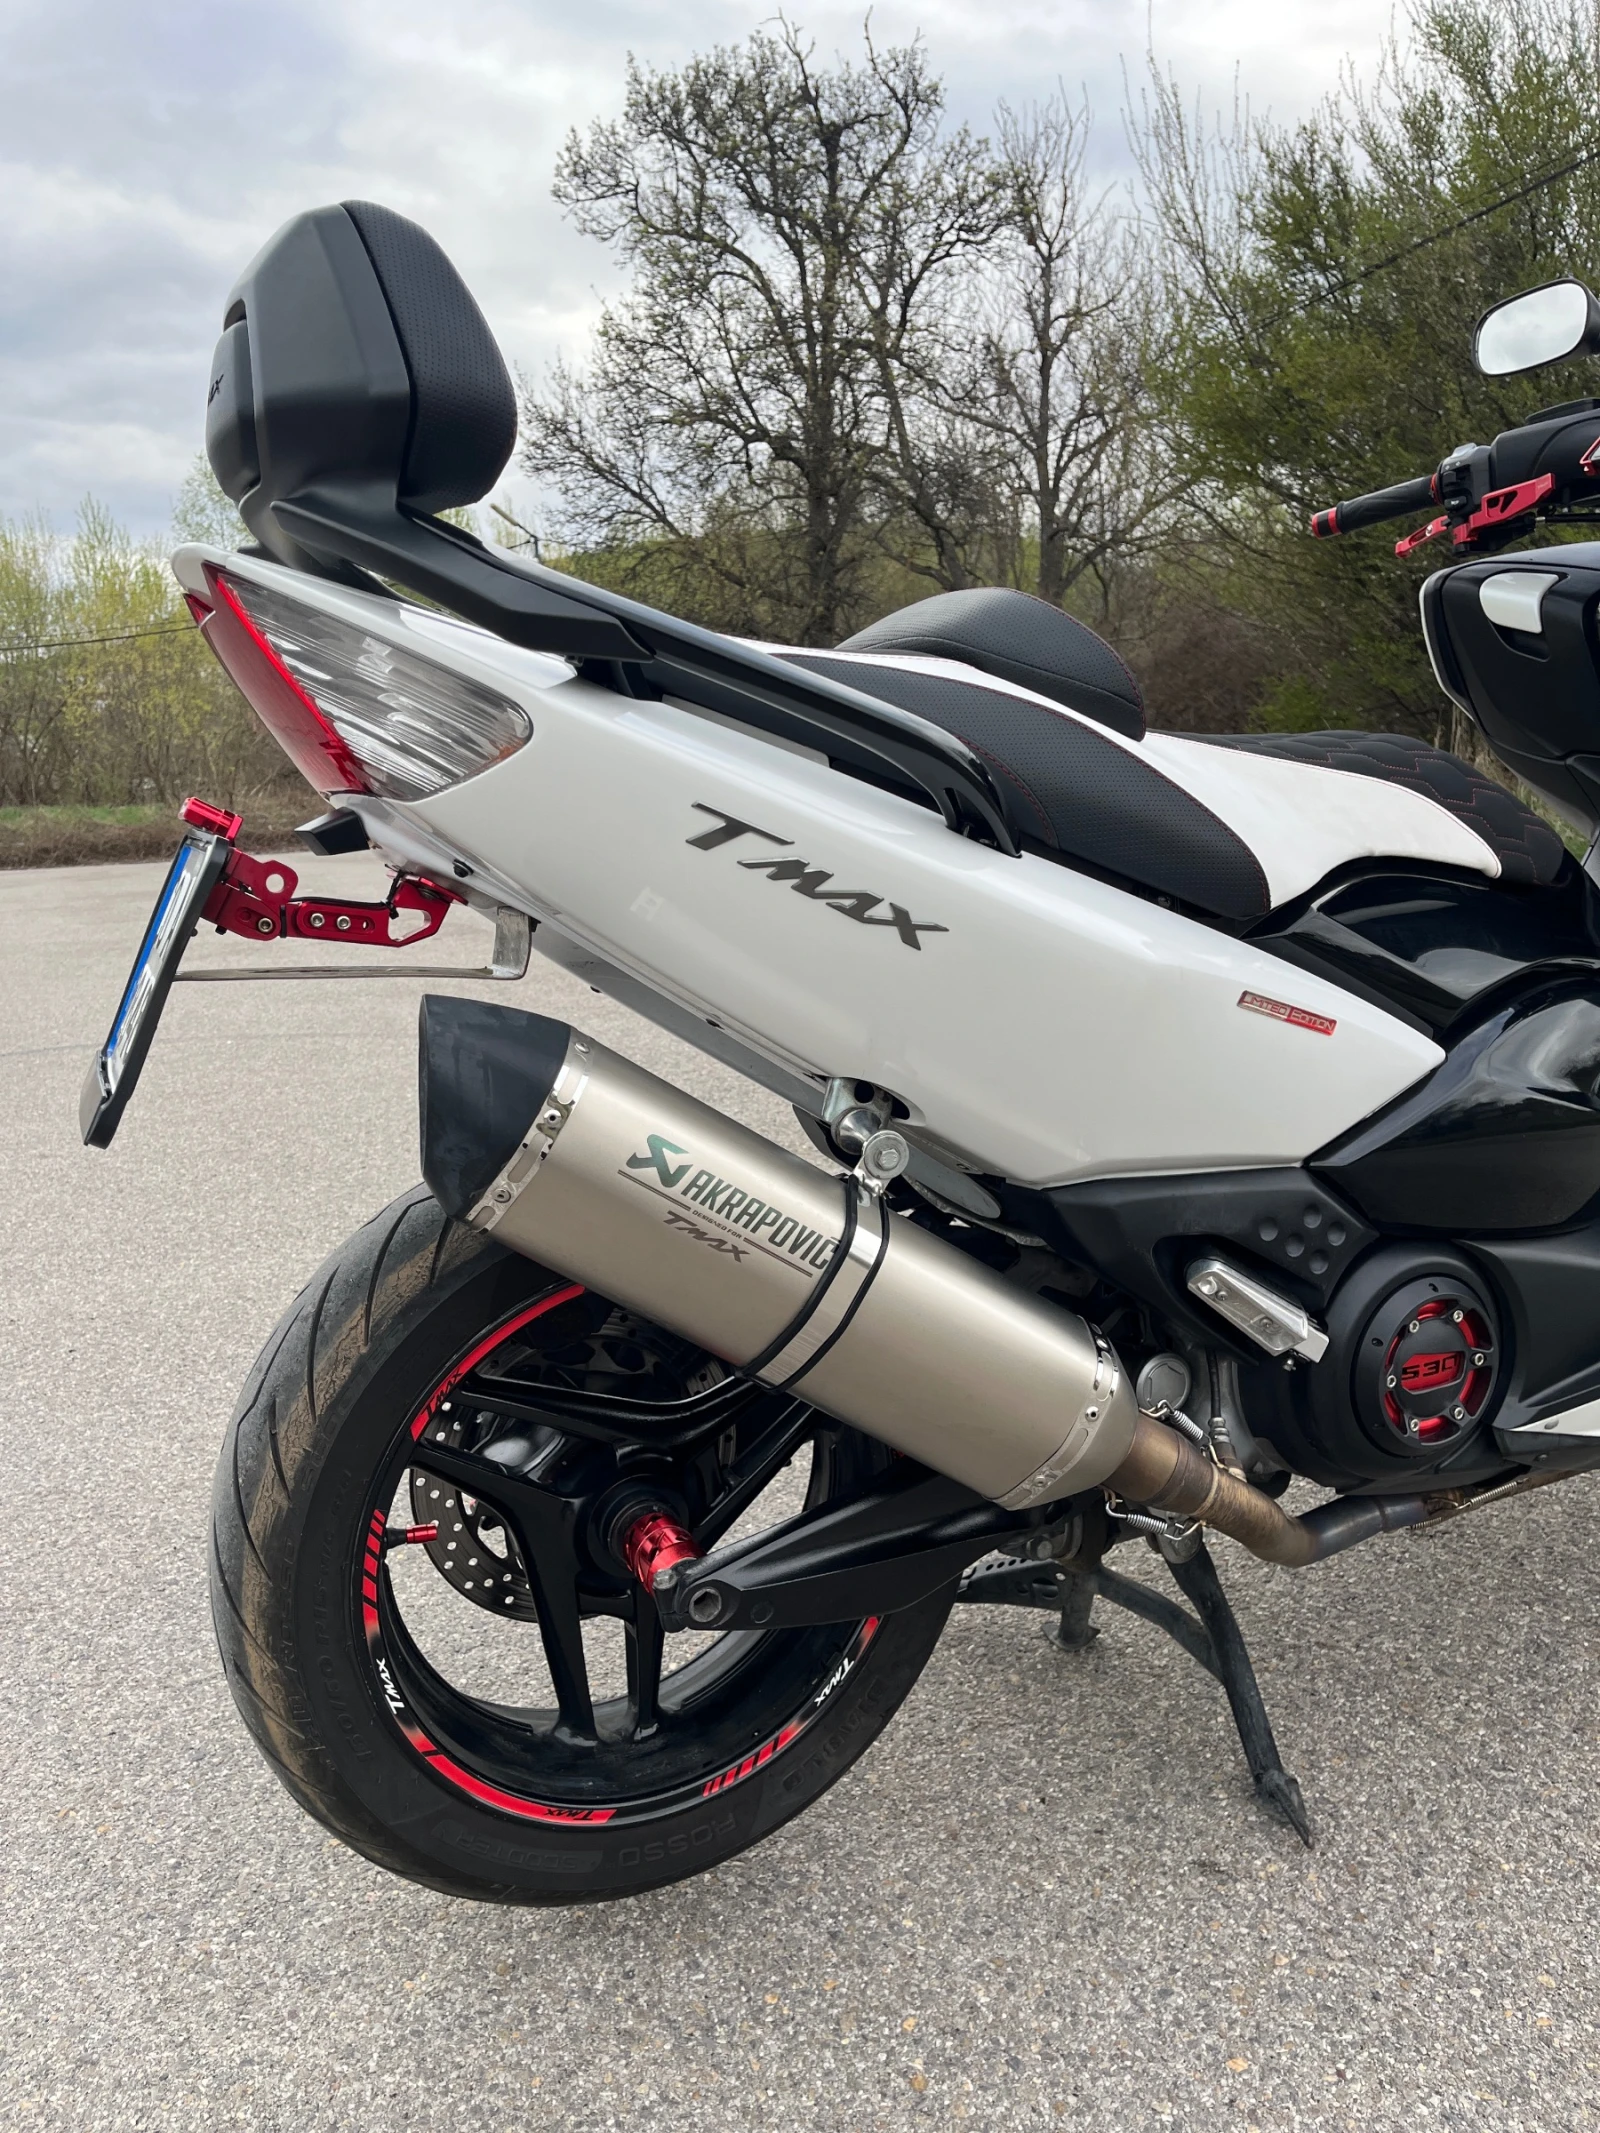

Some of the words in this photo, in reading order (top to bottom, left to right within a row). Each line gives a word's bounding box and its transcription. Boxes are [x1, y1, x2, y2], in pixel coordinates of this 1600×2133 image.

[692, 1209, 727, 1233] DESIGNED
[727, 1228, 743, 1240] FOR
[1401, 1354, 1458, 1381] 530
[617, 1811, 738, 1868] ROSSO
